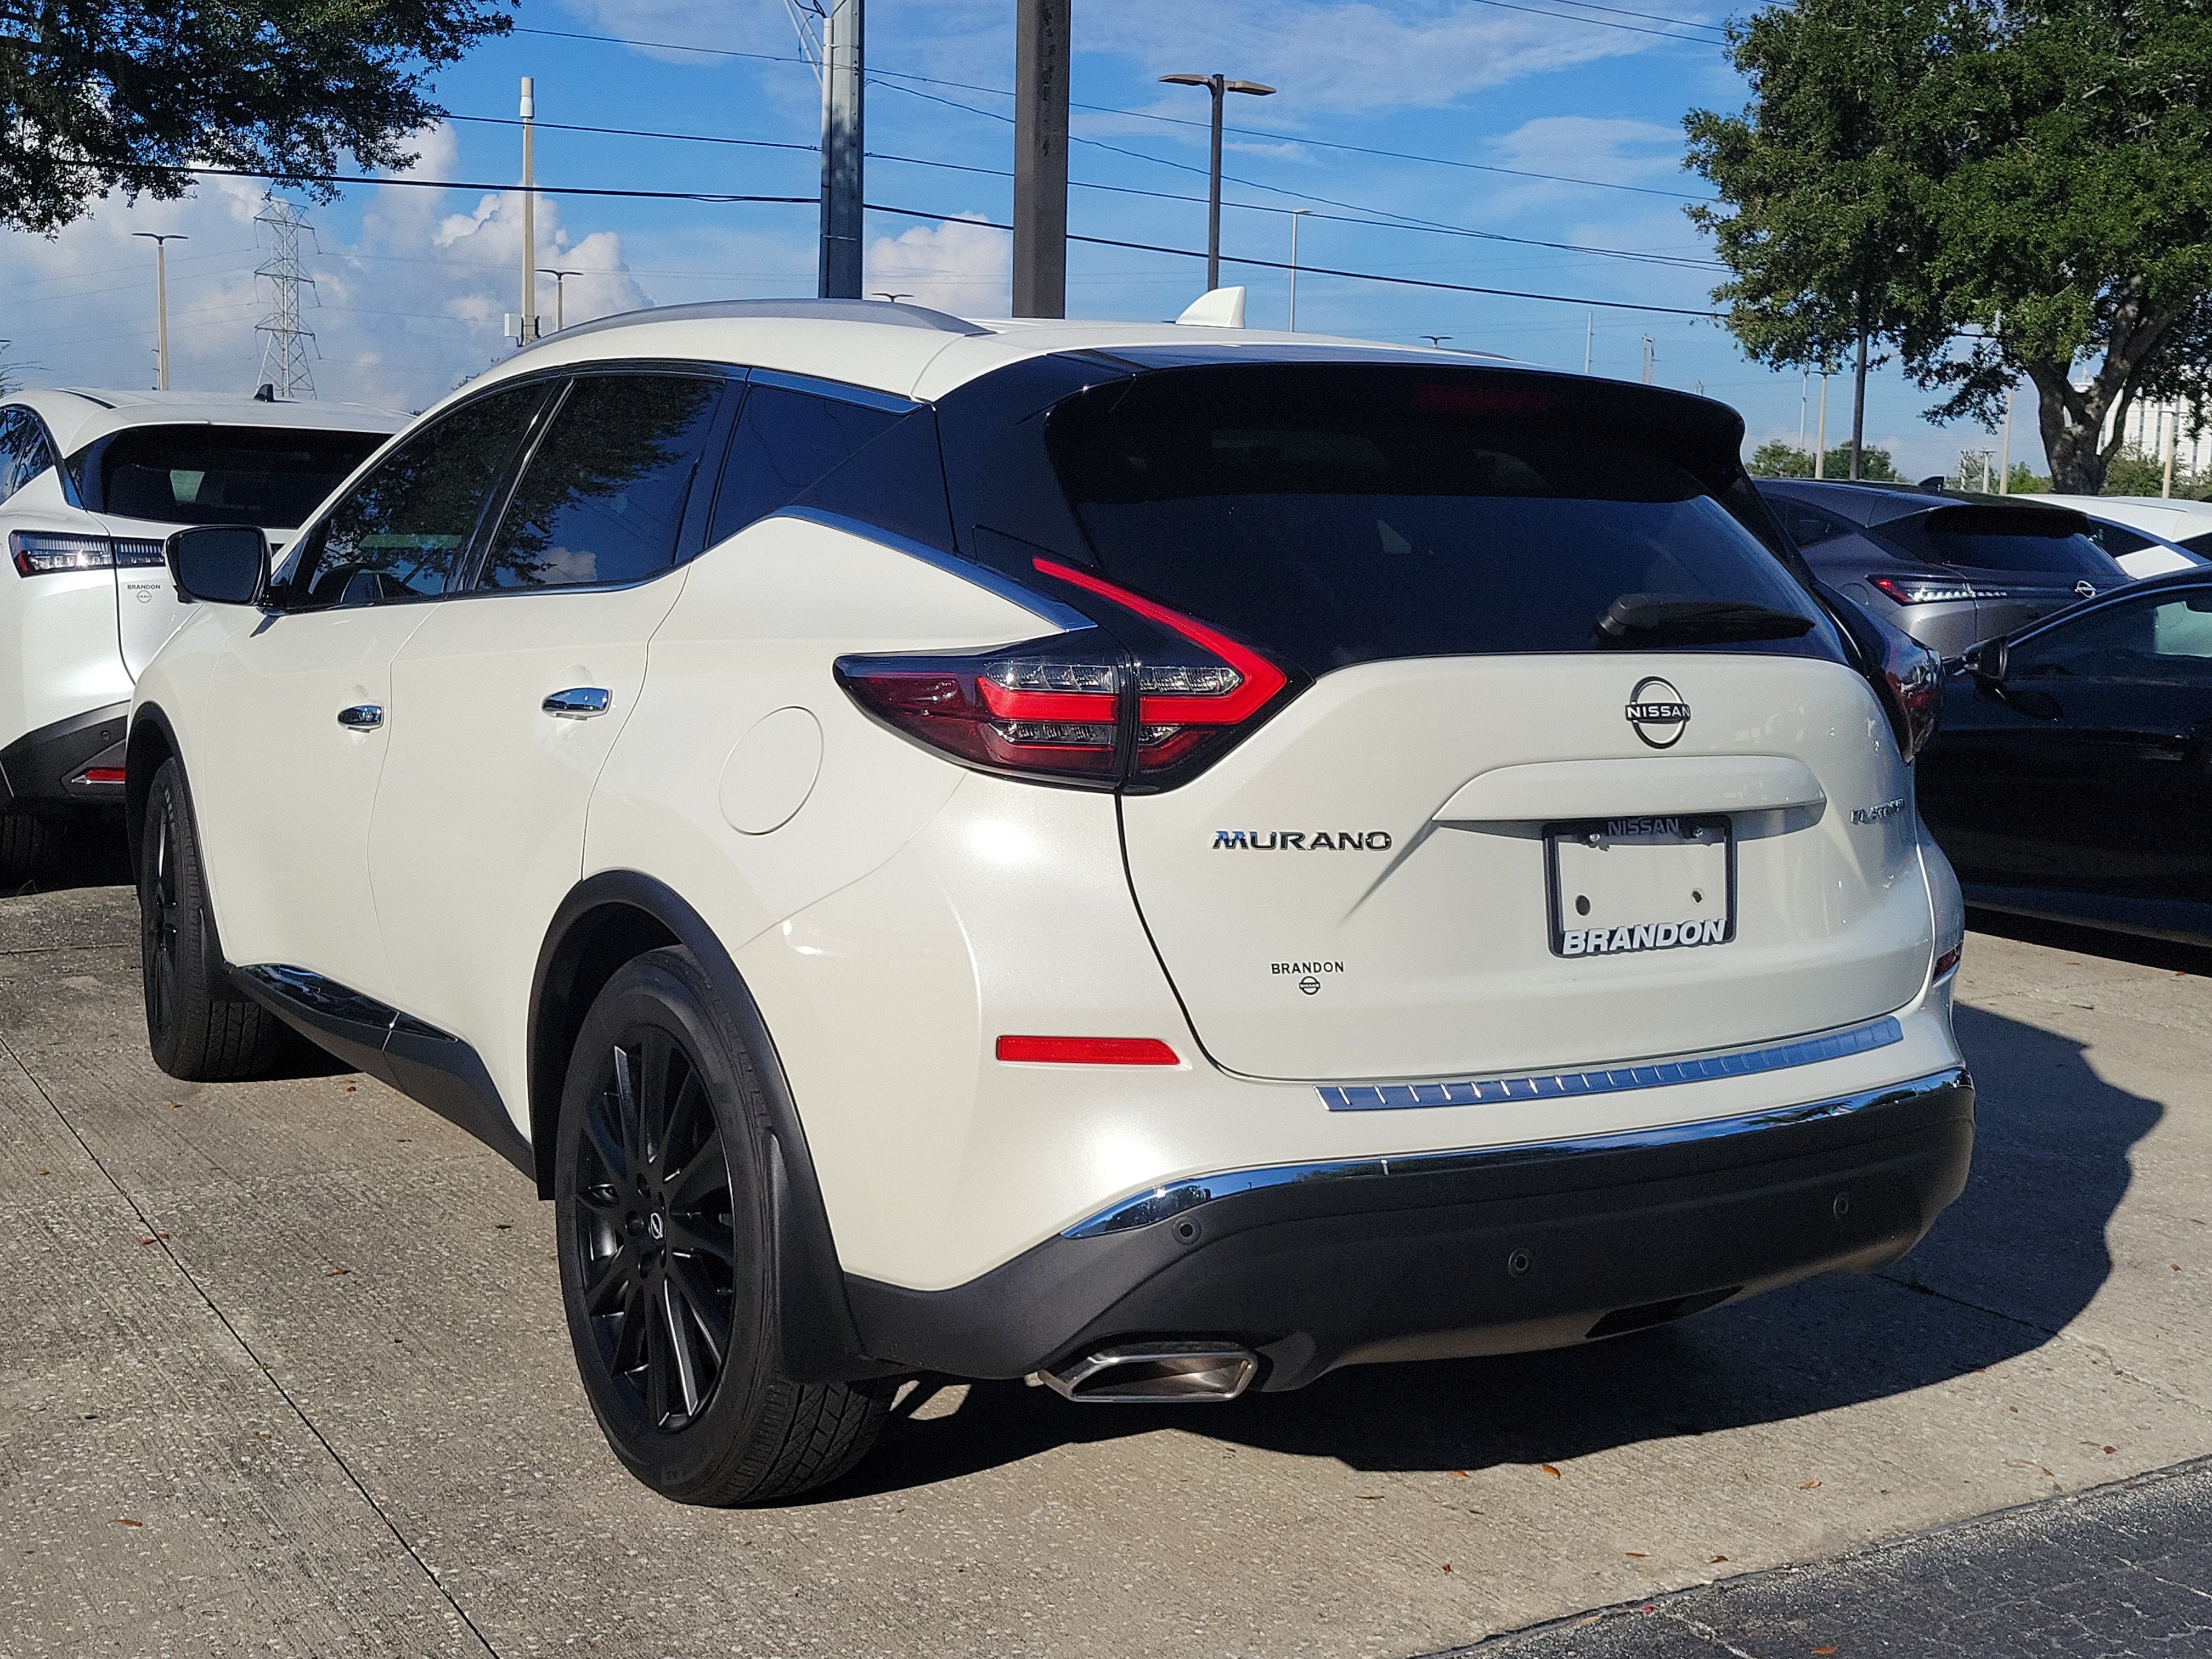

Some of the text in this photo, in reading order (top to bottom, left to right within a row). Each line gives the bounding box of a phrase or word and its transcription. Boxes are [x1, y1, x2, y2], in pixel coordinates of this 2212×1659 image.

[1627, 706, 1690, 718] NISSAN
[1607, 818, 1679, 836] NISSAN
[1212, 831, 1392, 851] MURANO
[1562, 919, 1725, 955] BRANDON
[1271, 961, 1344, 974] BRANDON
